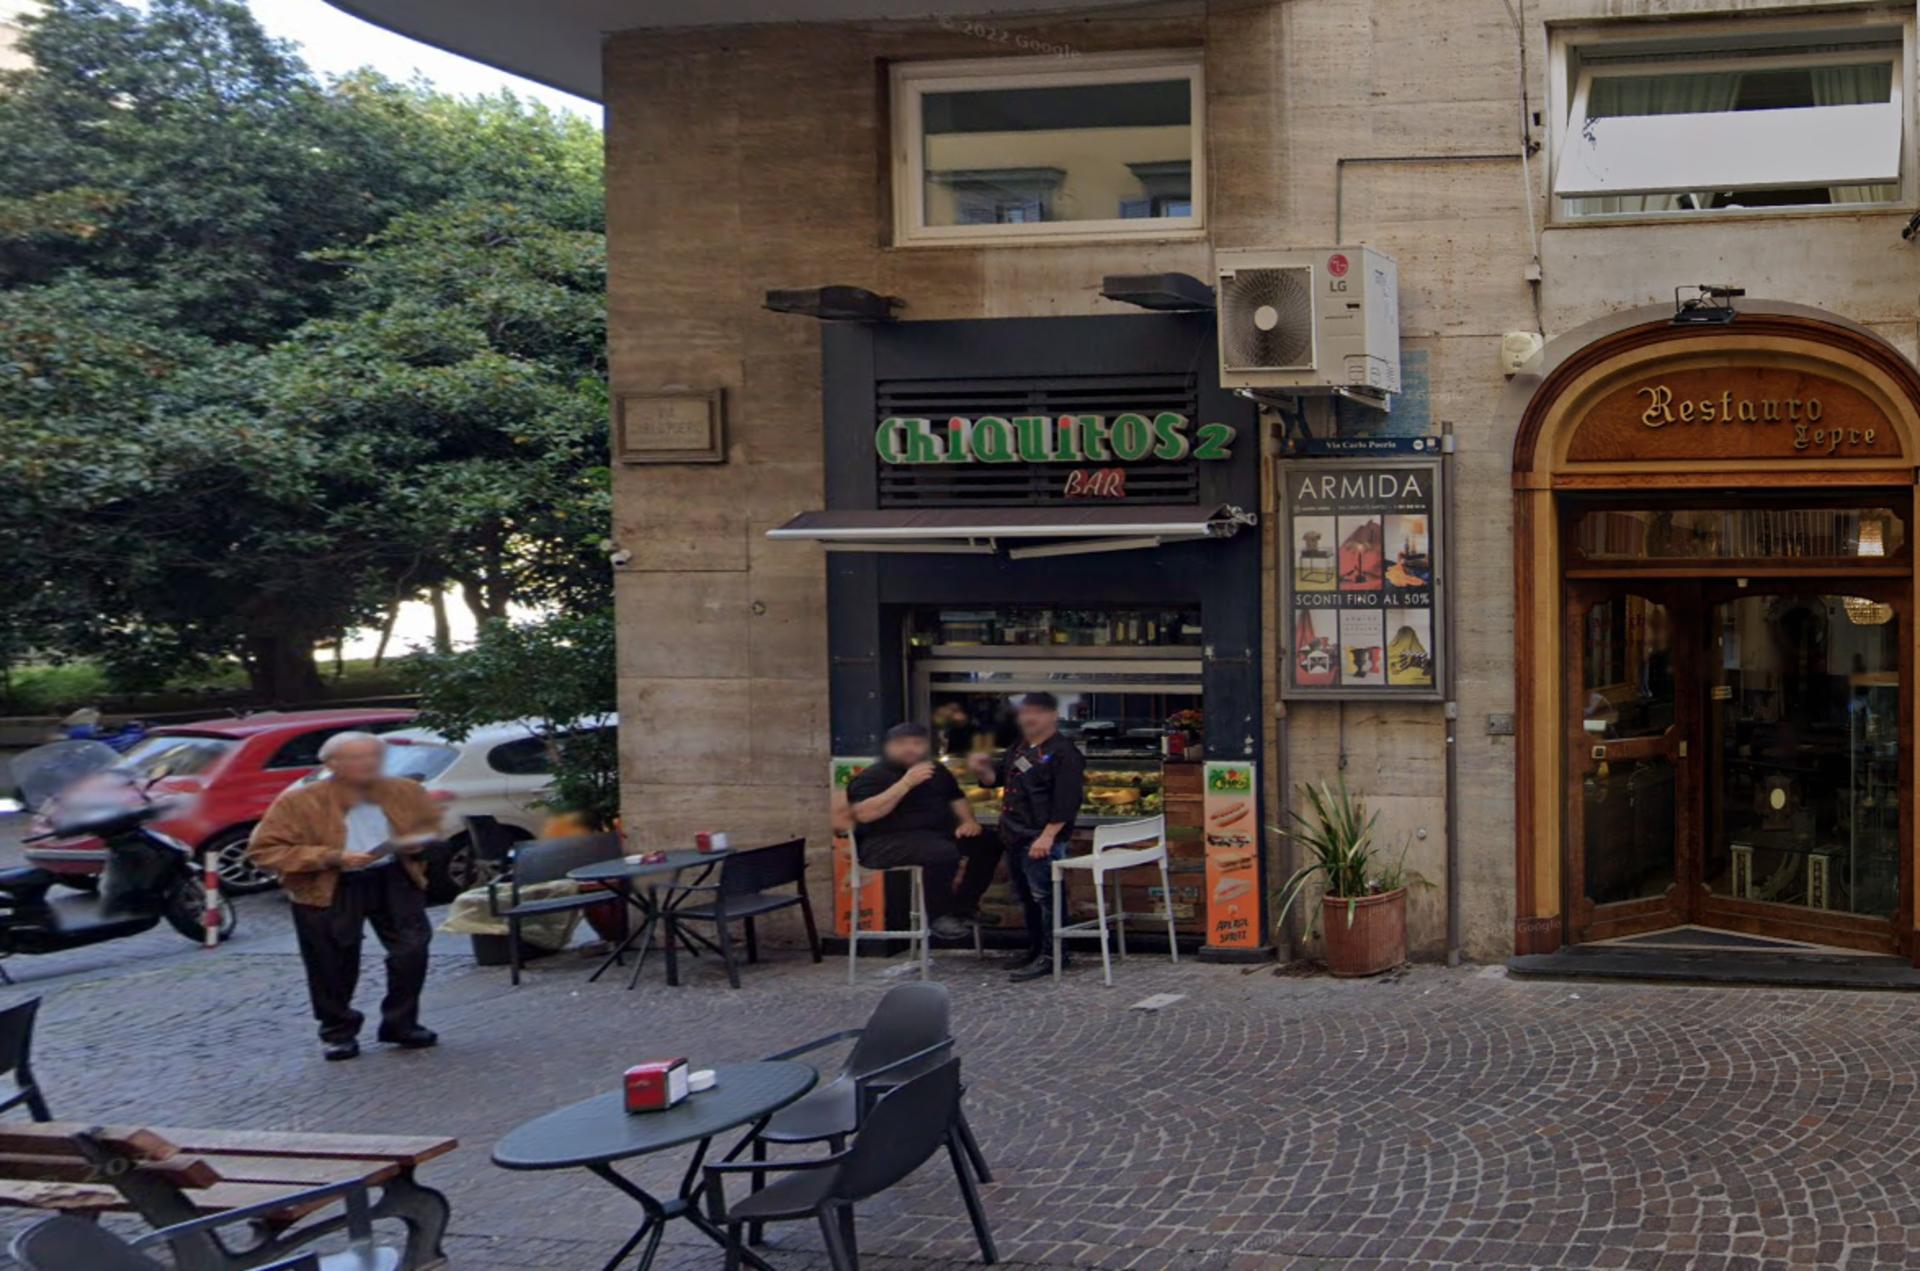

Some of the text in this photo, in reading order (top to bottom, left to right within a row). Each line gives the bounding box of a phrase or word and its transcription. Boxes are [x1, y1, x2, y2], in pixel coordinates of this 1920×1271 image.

[1329, 280, 1347, 292] LG
[1637, 385, 1823, 427] Restauro
[1193, 423, 1236, 460] 2
[1064, 468, 1126, 497] BAR
[1298, 473, 1423, 500] ARMIDA
[1295, 592, 1430, 606] SCONTI FINO AL 50%
